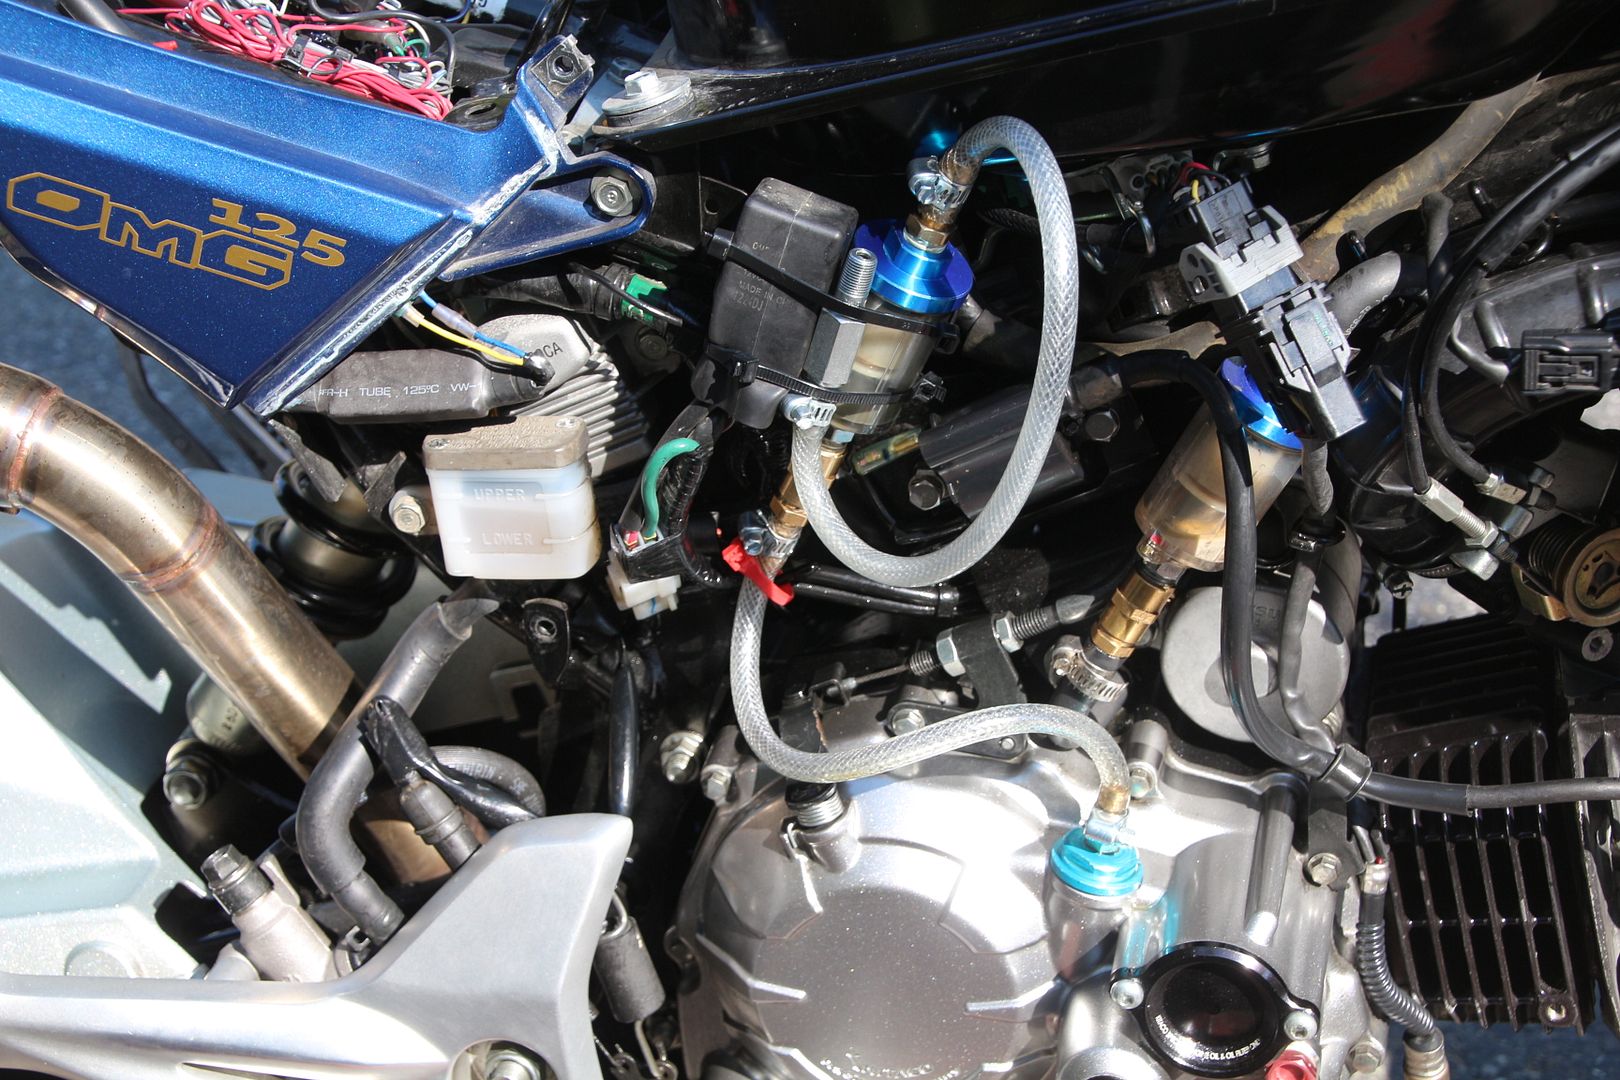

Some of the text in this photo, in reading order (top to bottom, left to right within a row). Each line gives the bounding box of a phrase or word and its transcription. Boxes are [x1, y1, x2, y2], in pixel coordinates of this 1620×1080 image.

[6, 172, 295, 291] OMG
[208, 198, 347, 267] 125
[359, 386, 392, 398] TUBE
[473, 488, 527, 501] UPPER
[481, 532, 535, 546] LOWER
